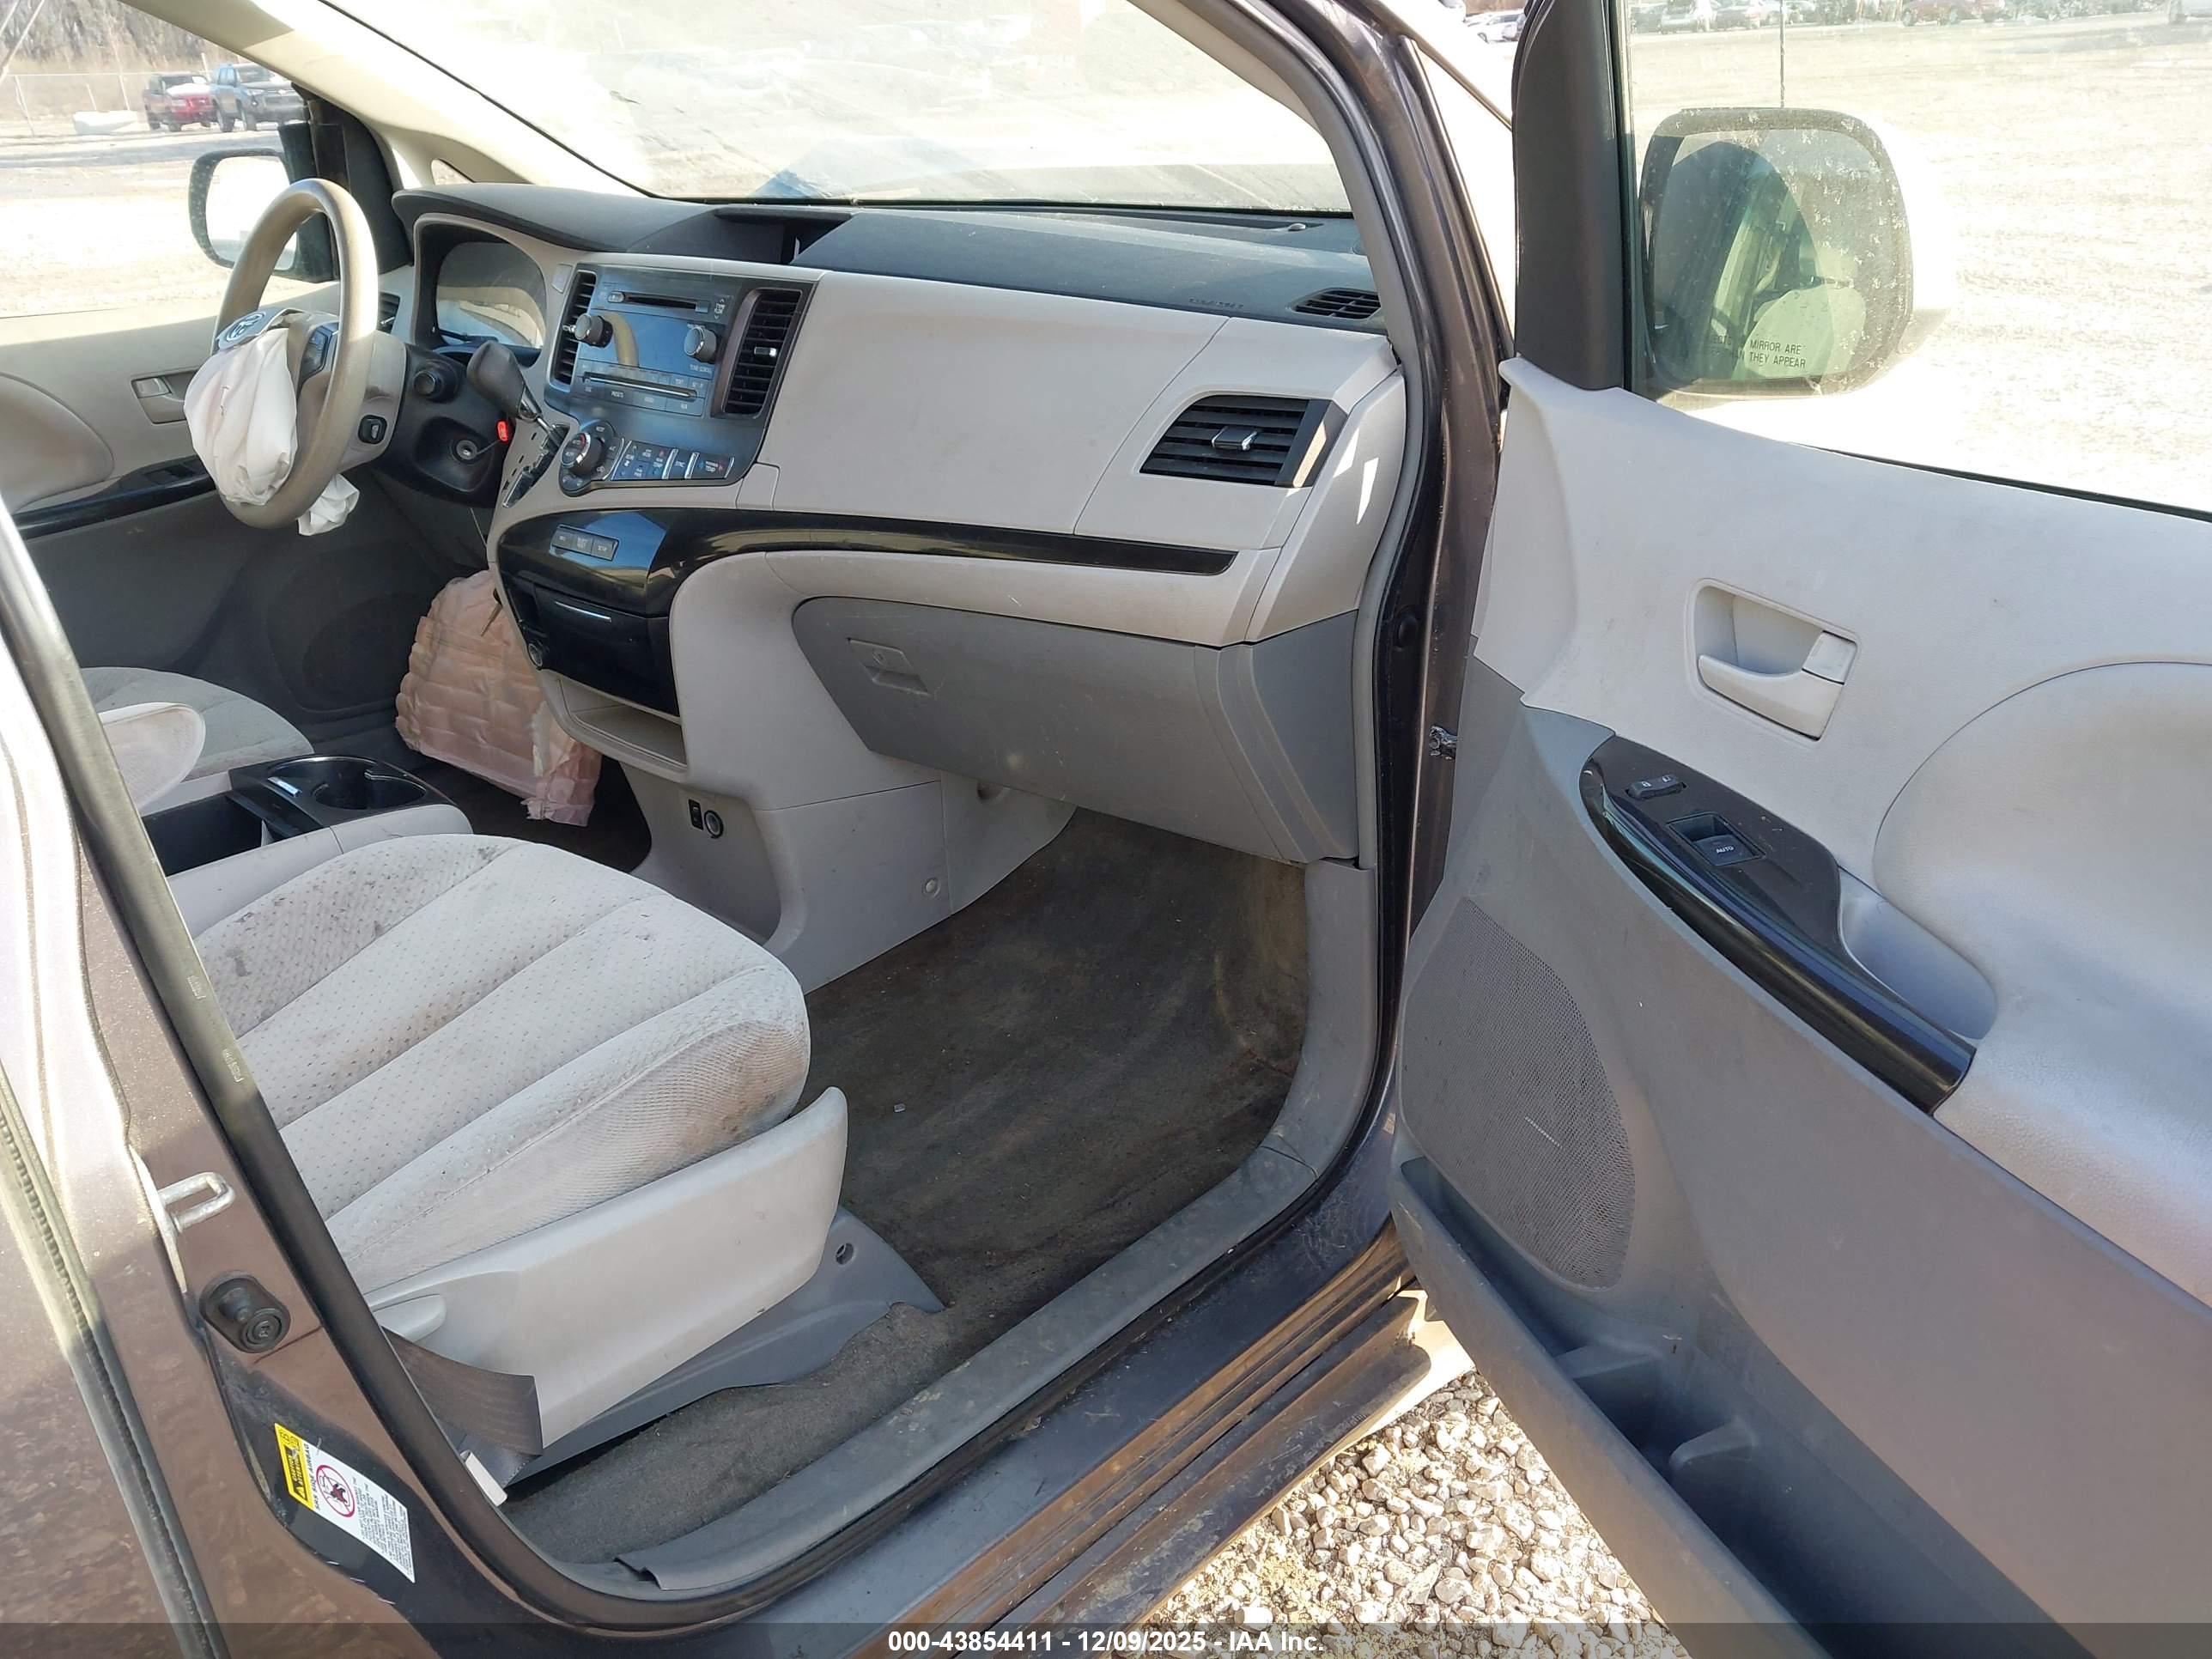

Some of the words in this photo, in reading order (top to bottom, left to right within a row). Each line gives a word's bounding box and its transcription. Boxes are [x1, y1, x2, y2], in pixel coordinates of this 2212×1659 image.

[1750, 339, 1781, 352] MIRROR
[1784, 343, 1802, 355] ARE
[1749, 351, 1771, 363] THEY
[1773, 356, 1807, 368] APPEAR
[1716, 845, 1735, 854] AUTO
[303, 1443, 314, 1473] AIRBAG
[308, 1474, 318, 1493] SIDE
[312, 1494, 320, 1511] SRS
